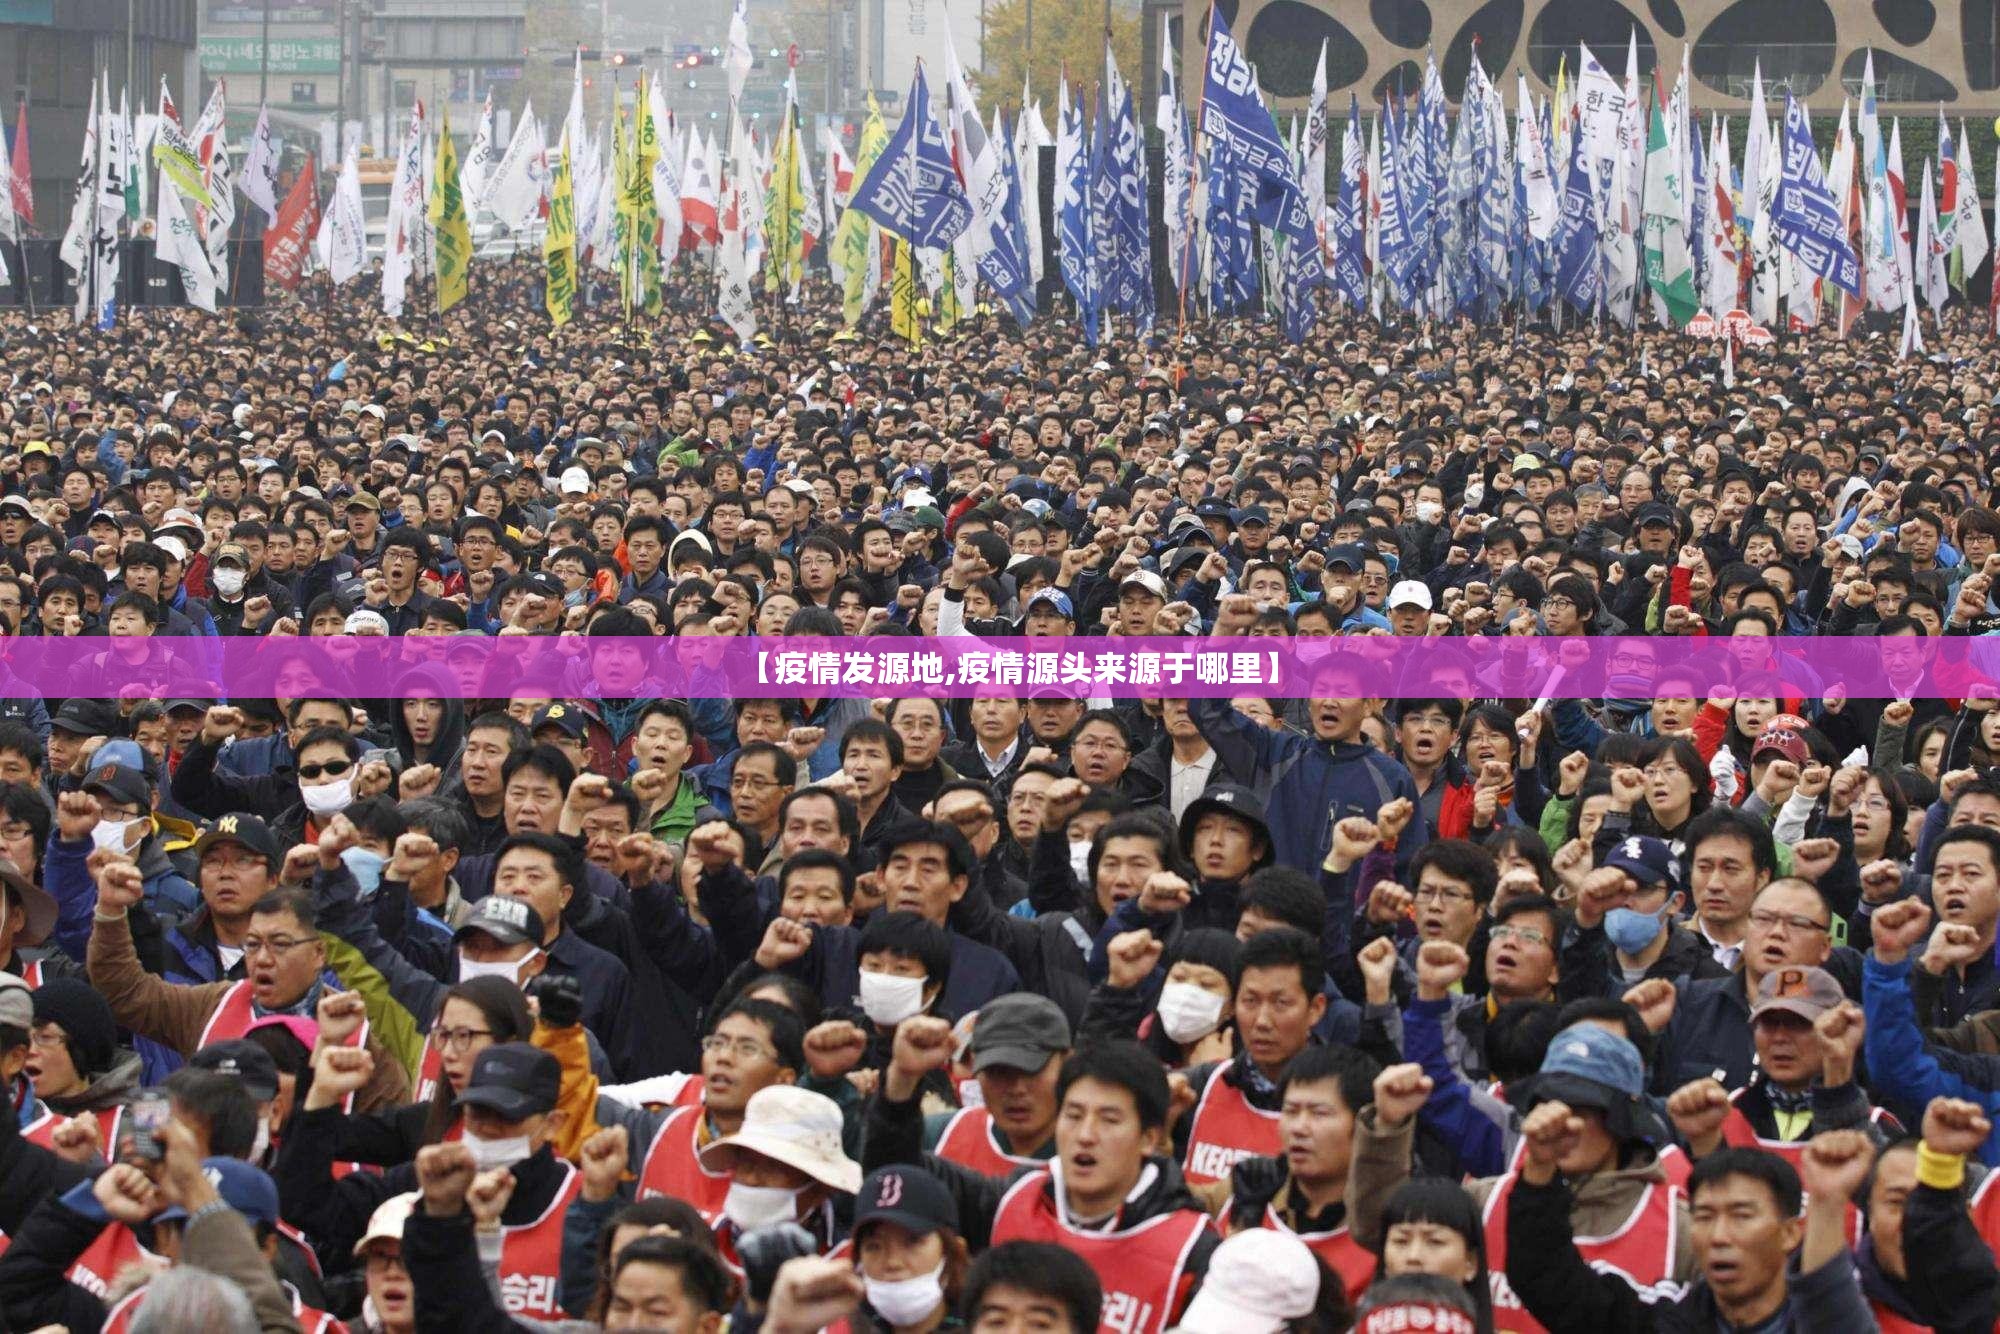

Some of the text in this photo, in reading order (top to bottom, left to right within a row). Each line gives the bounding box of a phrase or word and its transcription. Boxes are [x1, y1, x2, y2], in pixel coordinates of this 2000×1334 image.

[218, 815, 239, 835] NY
[876, 1174, 902, 1207] B
[501, 1273, 563, 1315] 승리
[1100, 1291, 1152, 1334] 리!
